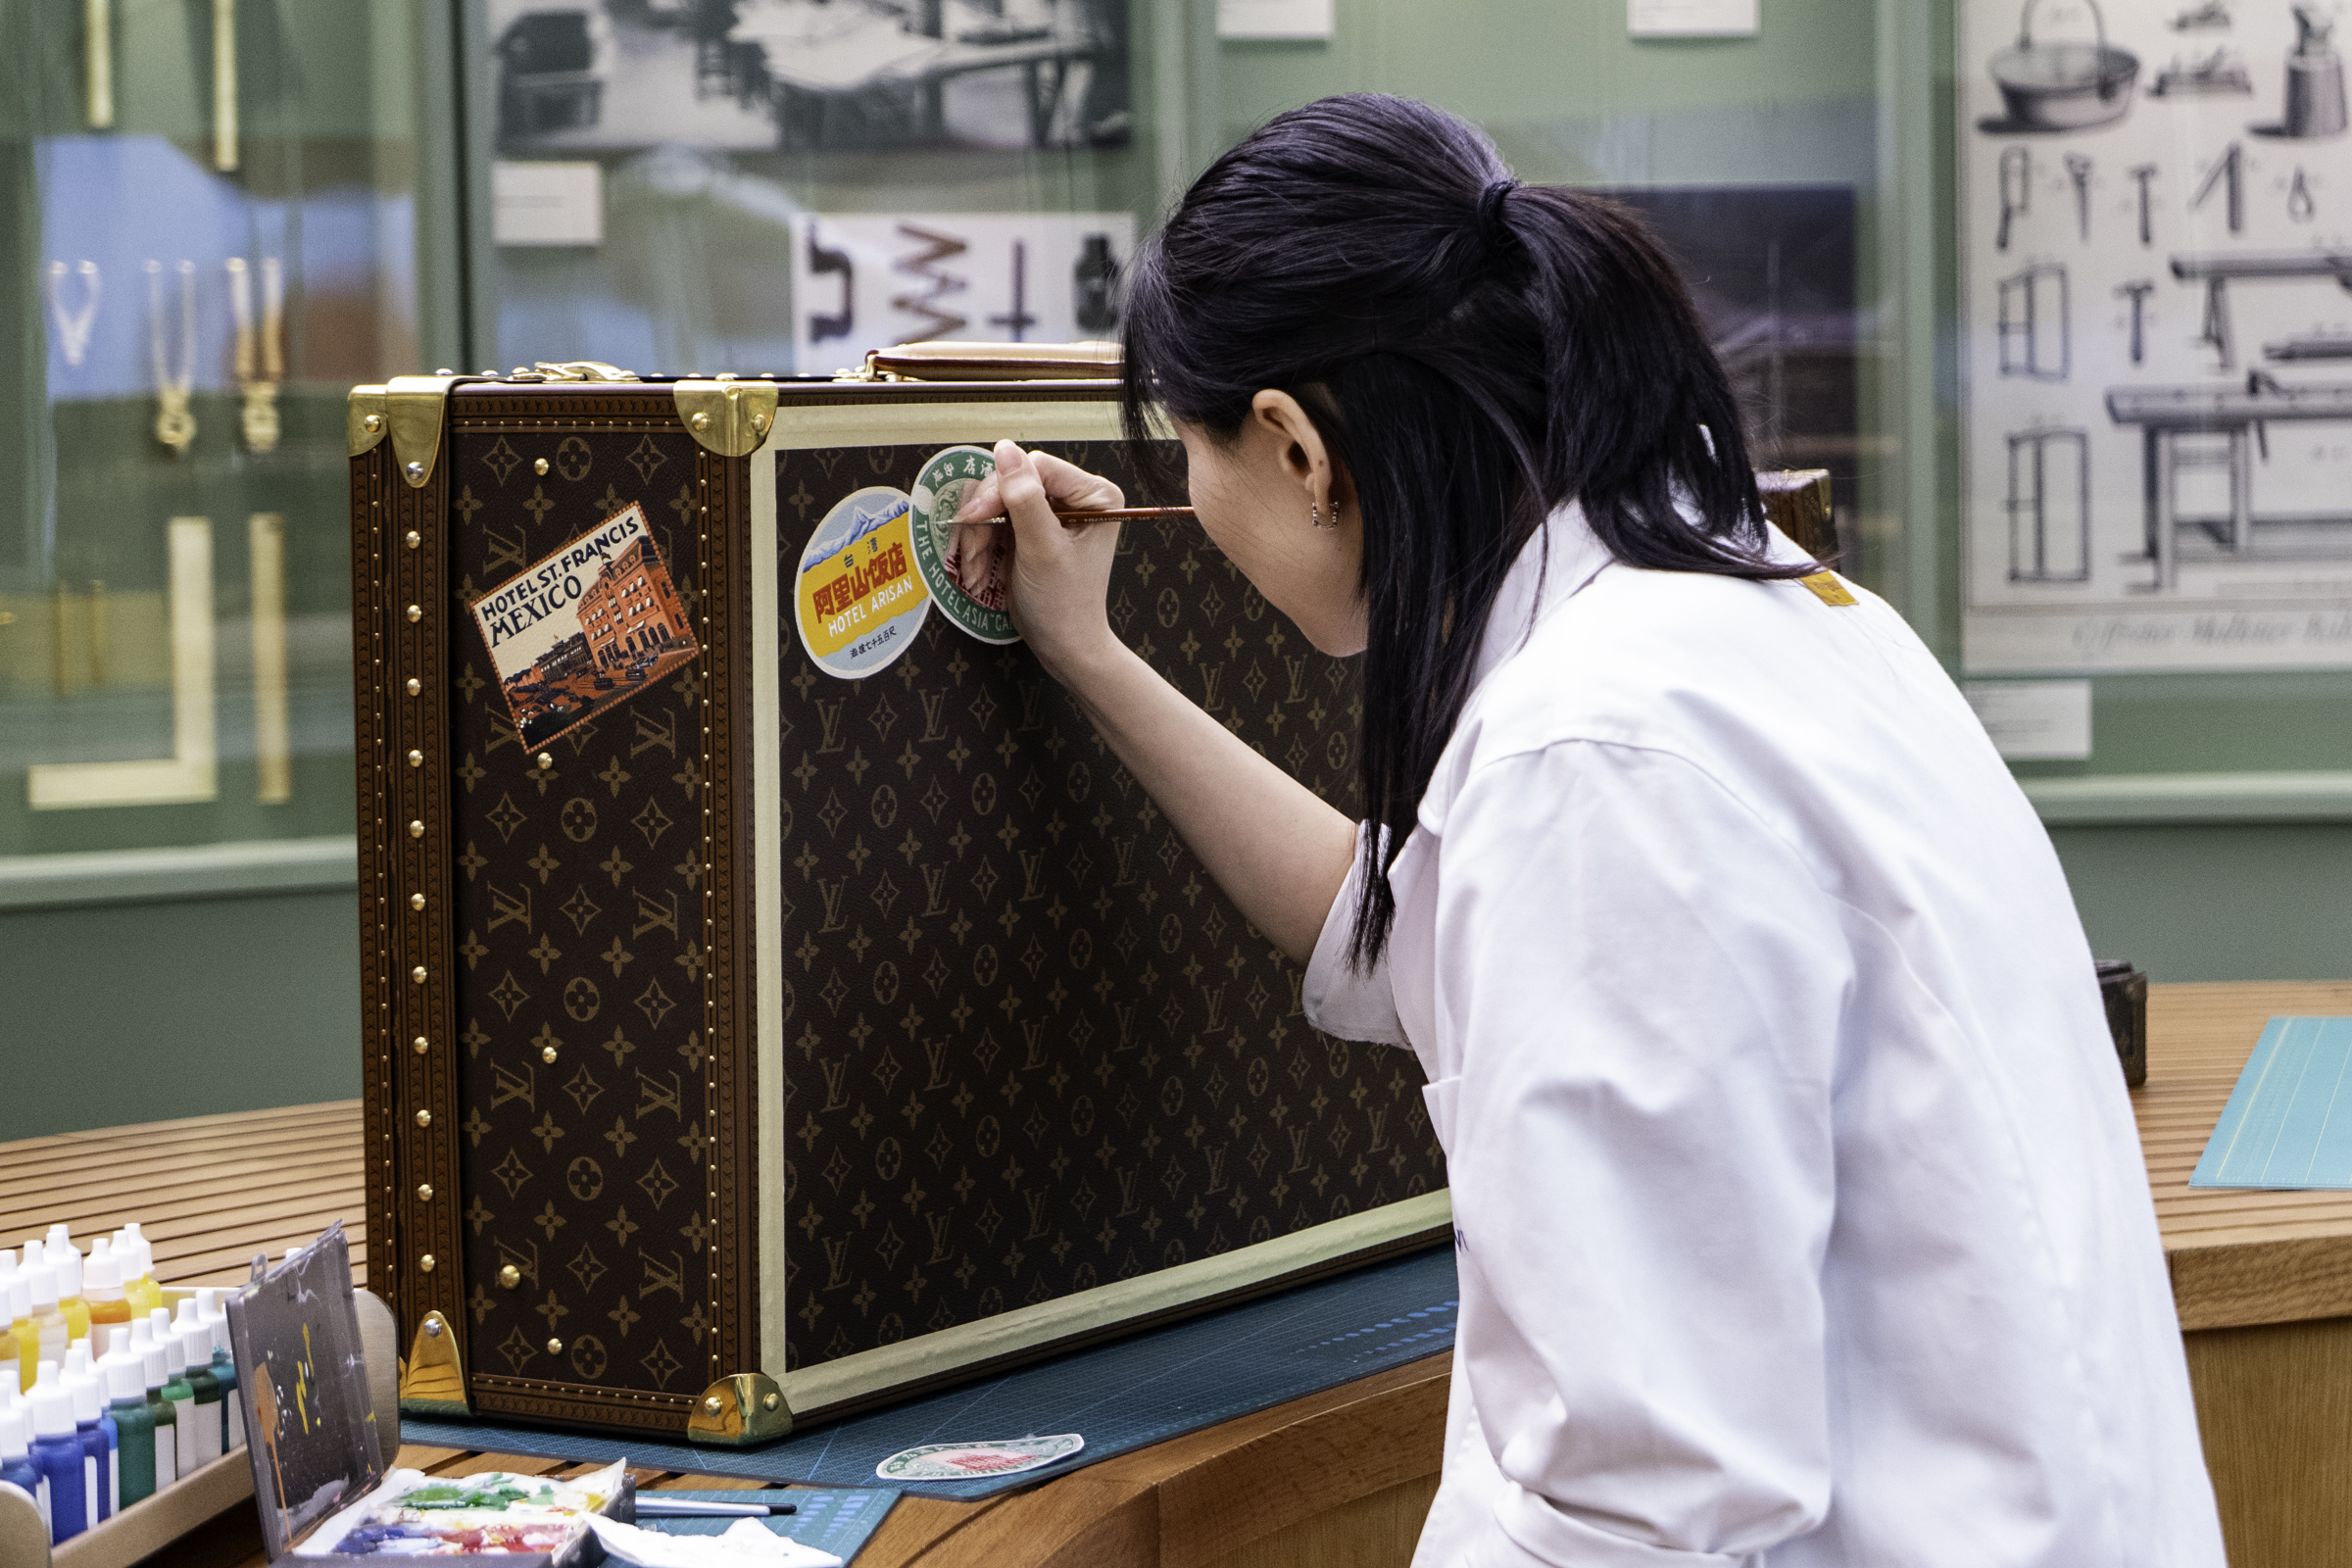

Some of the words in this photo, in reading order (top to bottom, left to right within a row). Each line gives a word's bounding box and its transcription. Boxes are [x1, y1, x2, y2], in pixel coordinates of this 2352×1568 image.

[481, 578, 538, 621] HOTEL
[536, 565, 563, 590] ST.
[561, 516, 639, 575] FRANCIS
[828, 604, 866, 638] HOTEL
[871, 575, 913, 613] ARISAN
[916, 520, 934, 561] THE
[928, 562, 960, 613] HOTEL
[489, 575, 582, 648] MEXICO
